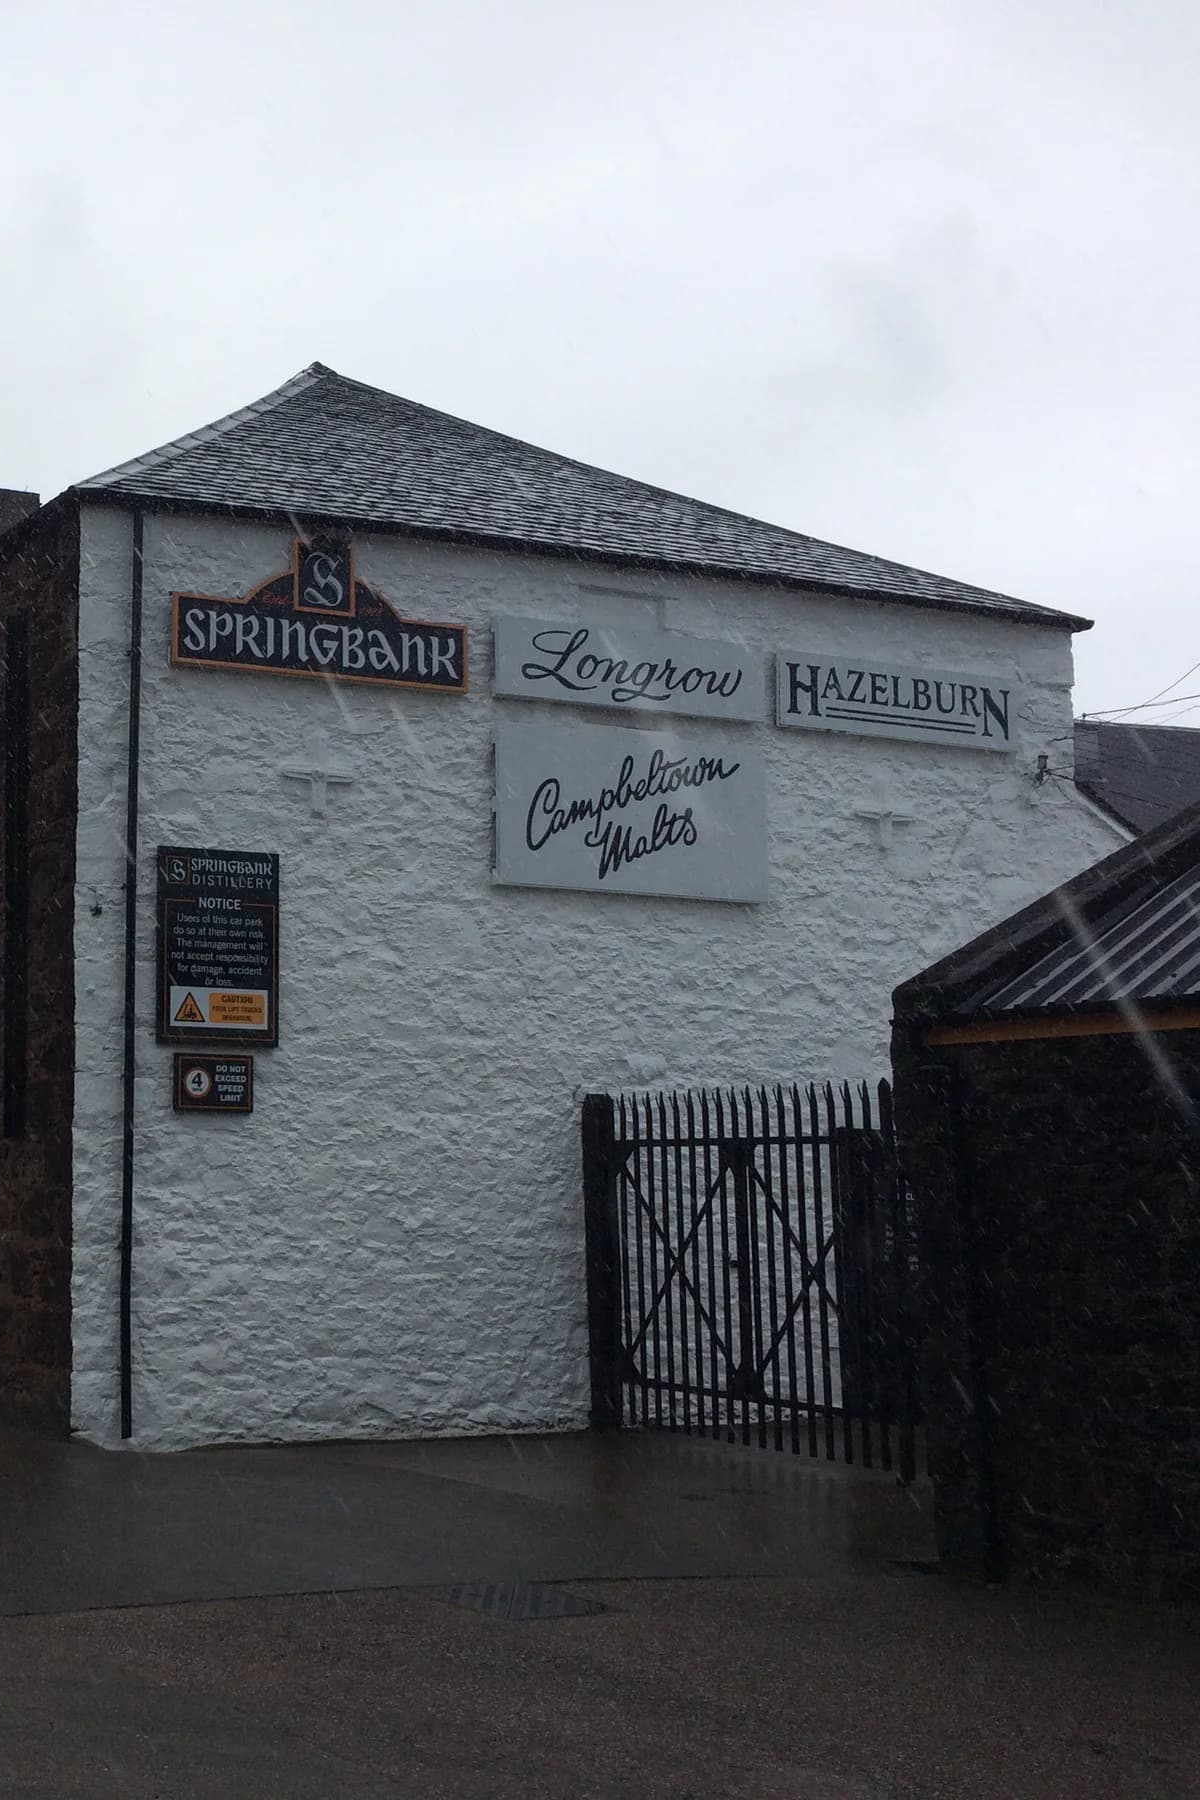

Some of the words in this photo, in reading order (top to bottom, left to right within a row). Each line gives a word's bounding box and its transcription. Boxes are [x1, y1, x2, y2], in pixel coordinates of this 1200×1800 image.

[304, 552, 343, 607] S
[183, 608, 459, 679] SPRINGBANK
[521, 628, 743, 702] Longrow
[785, 661, 1010, 741] HAZELBURN
[526, 749, 741, 851] Campbeltown
[584, 803, 698, 880] Malts
[191, 858, 273, 876] SPRINGBANK
[192, 874, 273, 890] DISTILLERY
[198, 897, 242, 910] NOTICE
[177, 913, 200, 923] Users
[202, 914, 210, 923] of
[212, 915, 228, 925] this
[230, 917, 242, 925] car
[245, 918, 264, 928] park
[173, 926, 184, 934] do
[198, 928, 206, 936] at
[208, 928, 228, 937] their
[229, 930, 247, 938] own
[176, 938, 193, 947] The
[194, 940, 247, 950] management
[248, 942, 264, 951] will
[171, 951, 184, 960] not
[187, 952, 214, 962] accept
[215, 954, 269, 966] responsibility
[177, 962, 189, 971] for
[228, 966, 263, 976] accident
[205, 978, 215, 986] or
[216, 977, 234, 987] loss.
[221, 994, 254, 1004] CAUTION
[216, 1065, 228, 1073] DO
[229, 1065, 247, 1073] NOT
[192, 1073, 203, 1088] 4
[215, 1074, 247, 1083] EXCEED
[217, 1084, 245, 1093] SPEED
[220, 1094, 241, 1102] LIMIT
